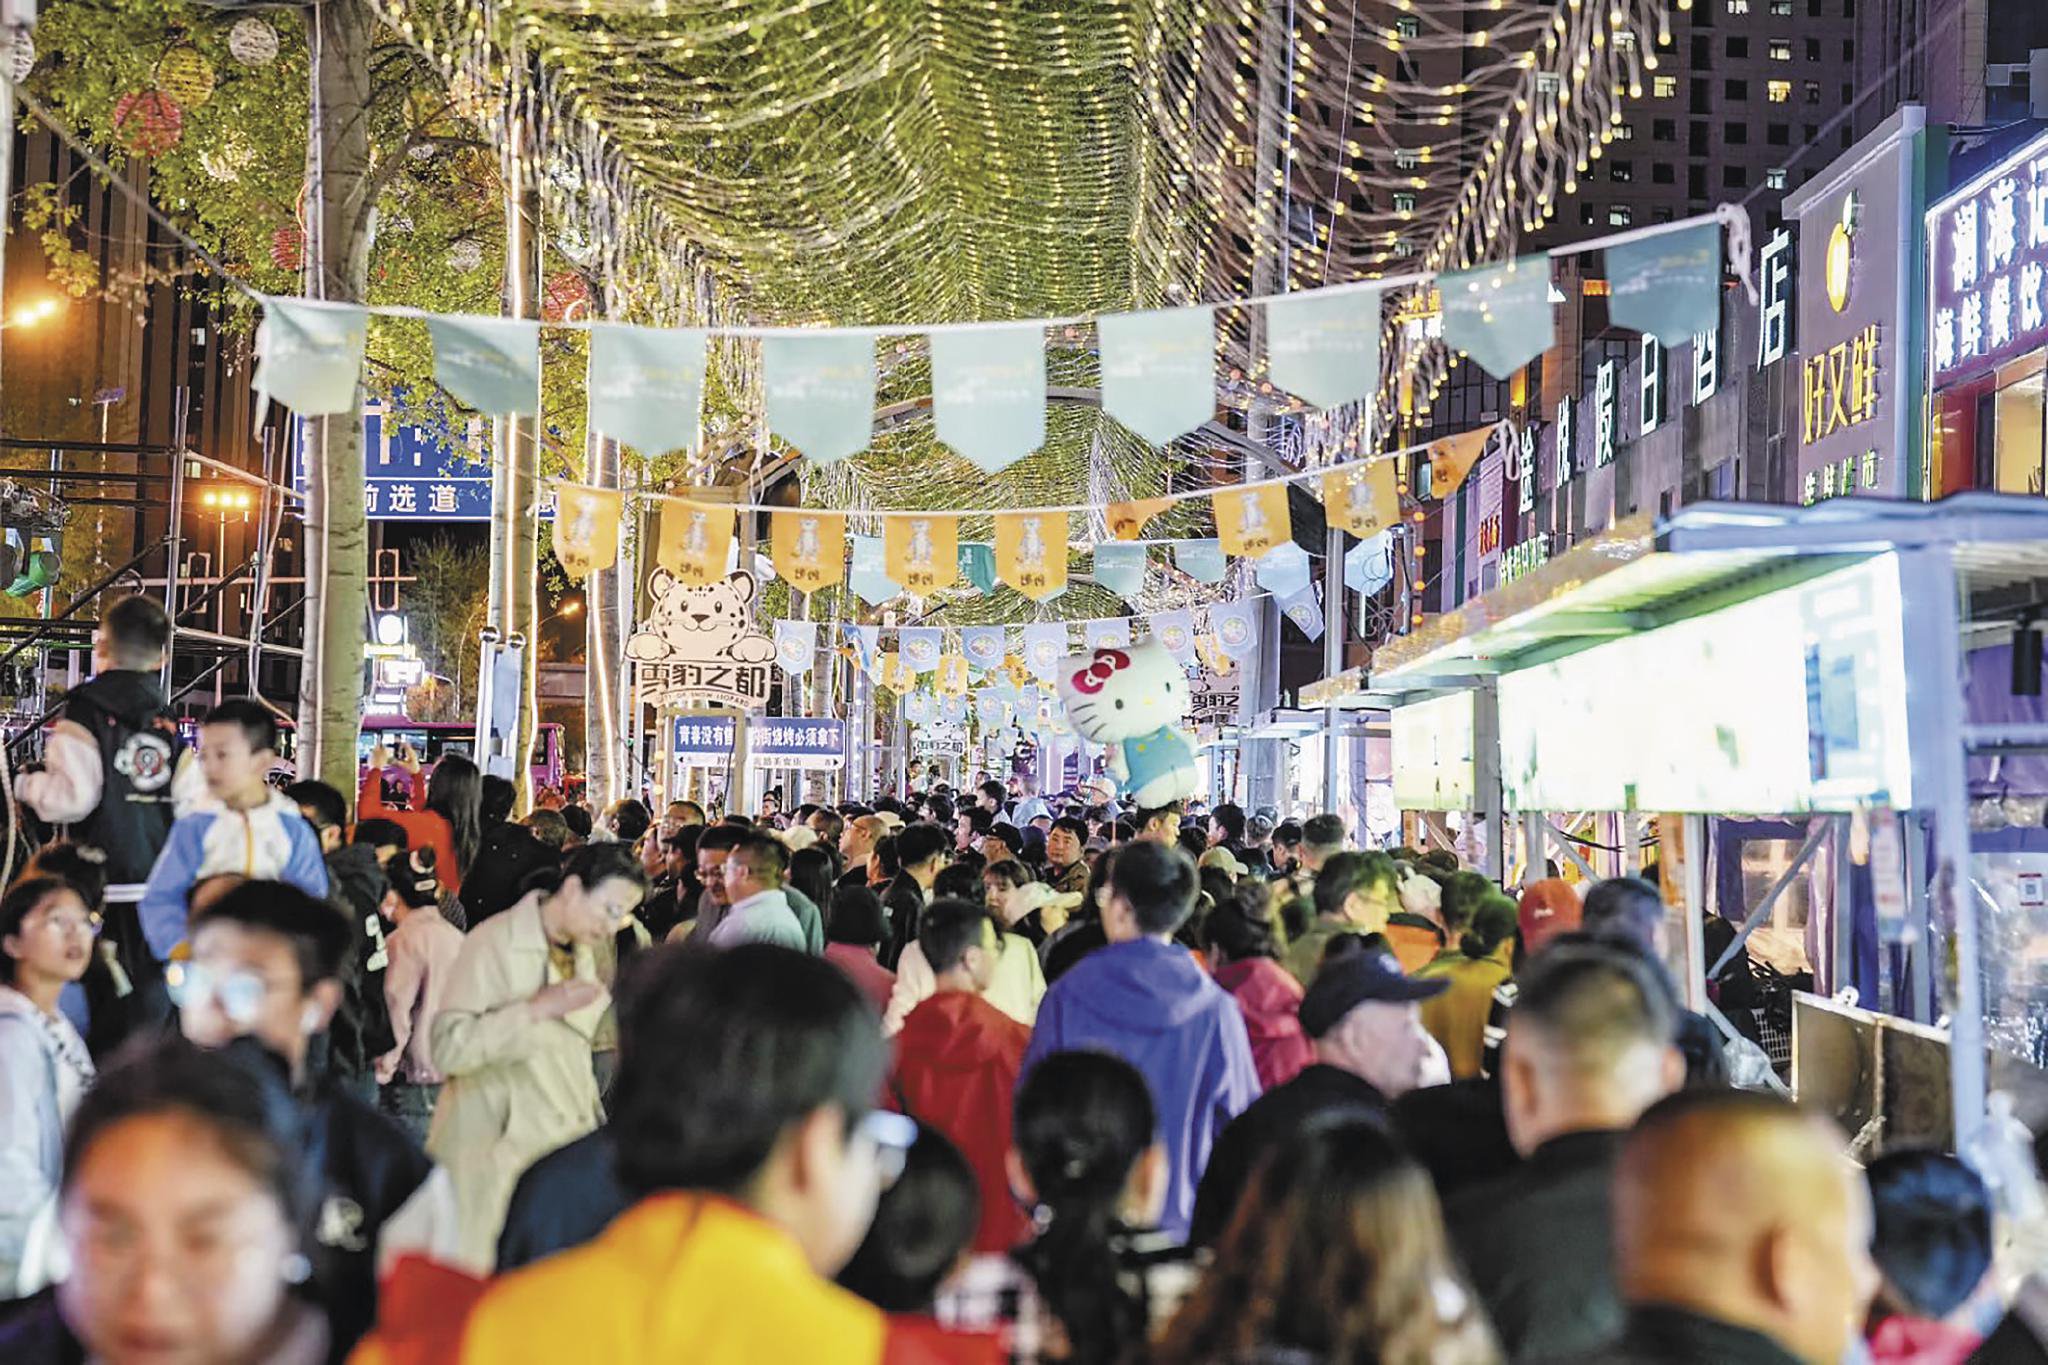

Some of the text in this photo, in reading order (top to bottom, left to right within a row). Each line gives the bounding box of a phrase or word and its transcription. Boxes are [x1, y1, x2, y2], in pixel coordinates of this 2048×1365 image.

[1803, 324, 1877, 444] 好又鲜
[641, 662, 766, 698] 雪豹之都
